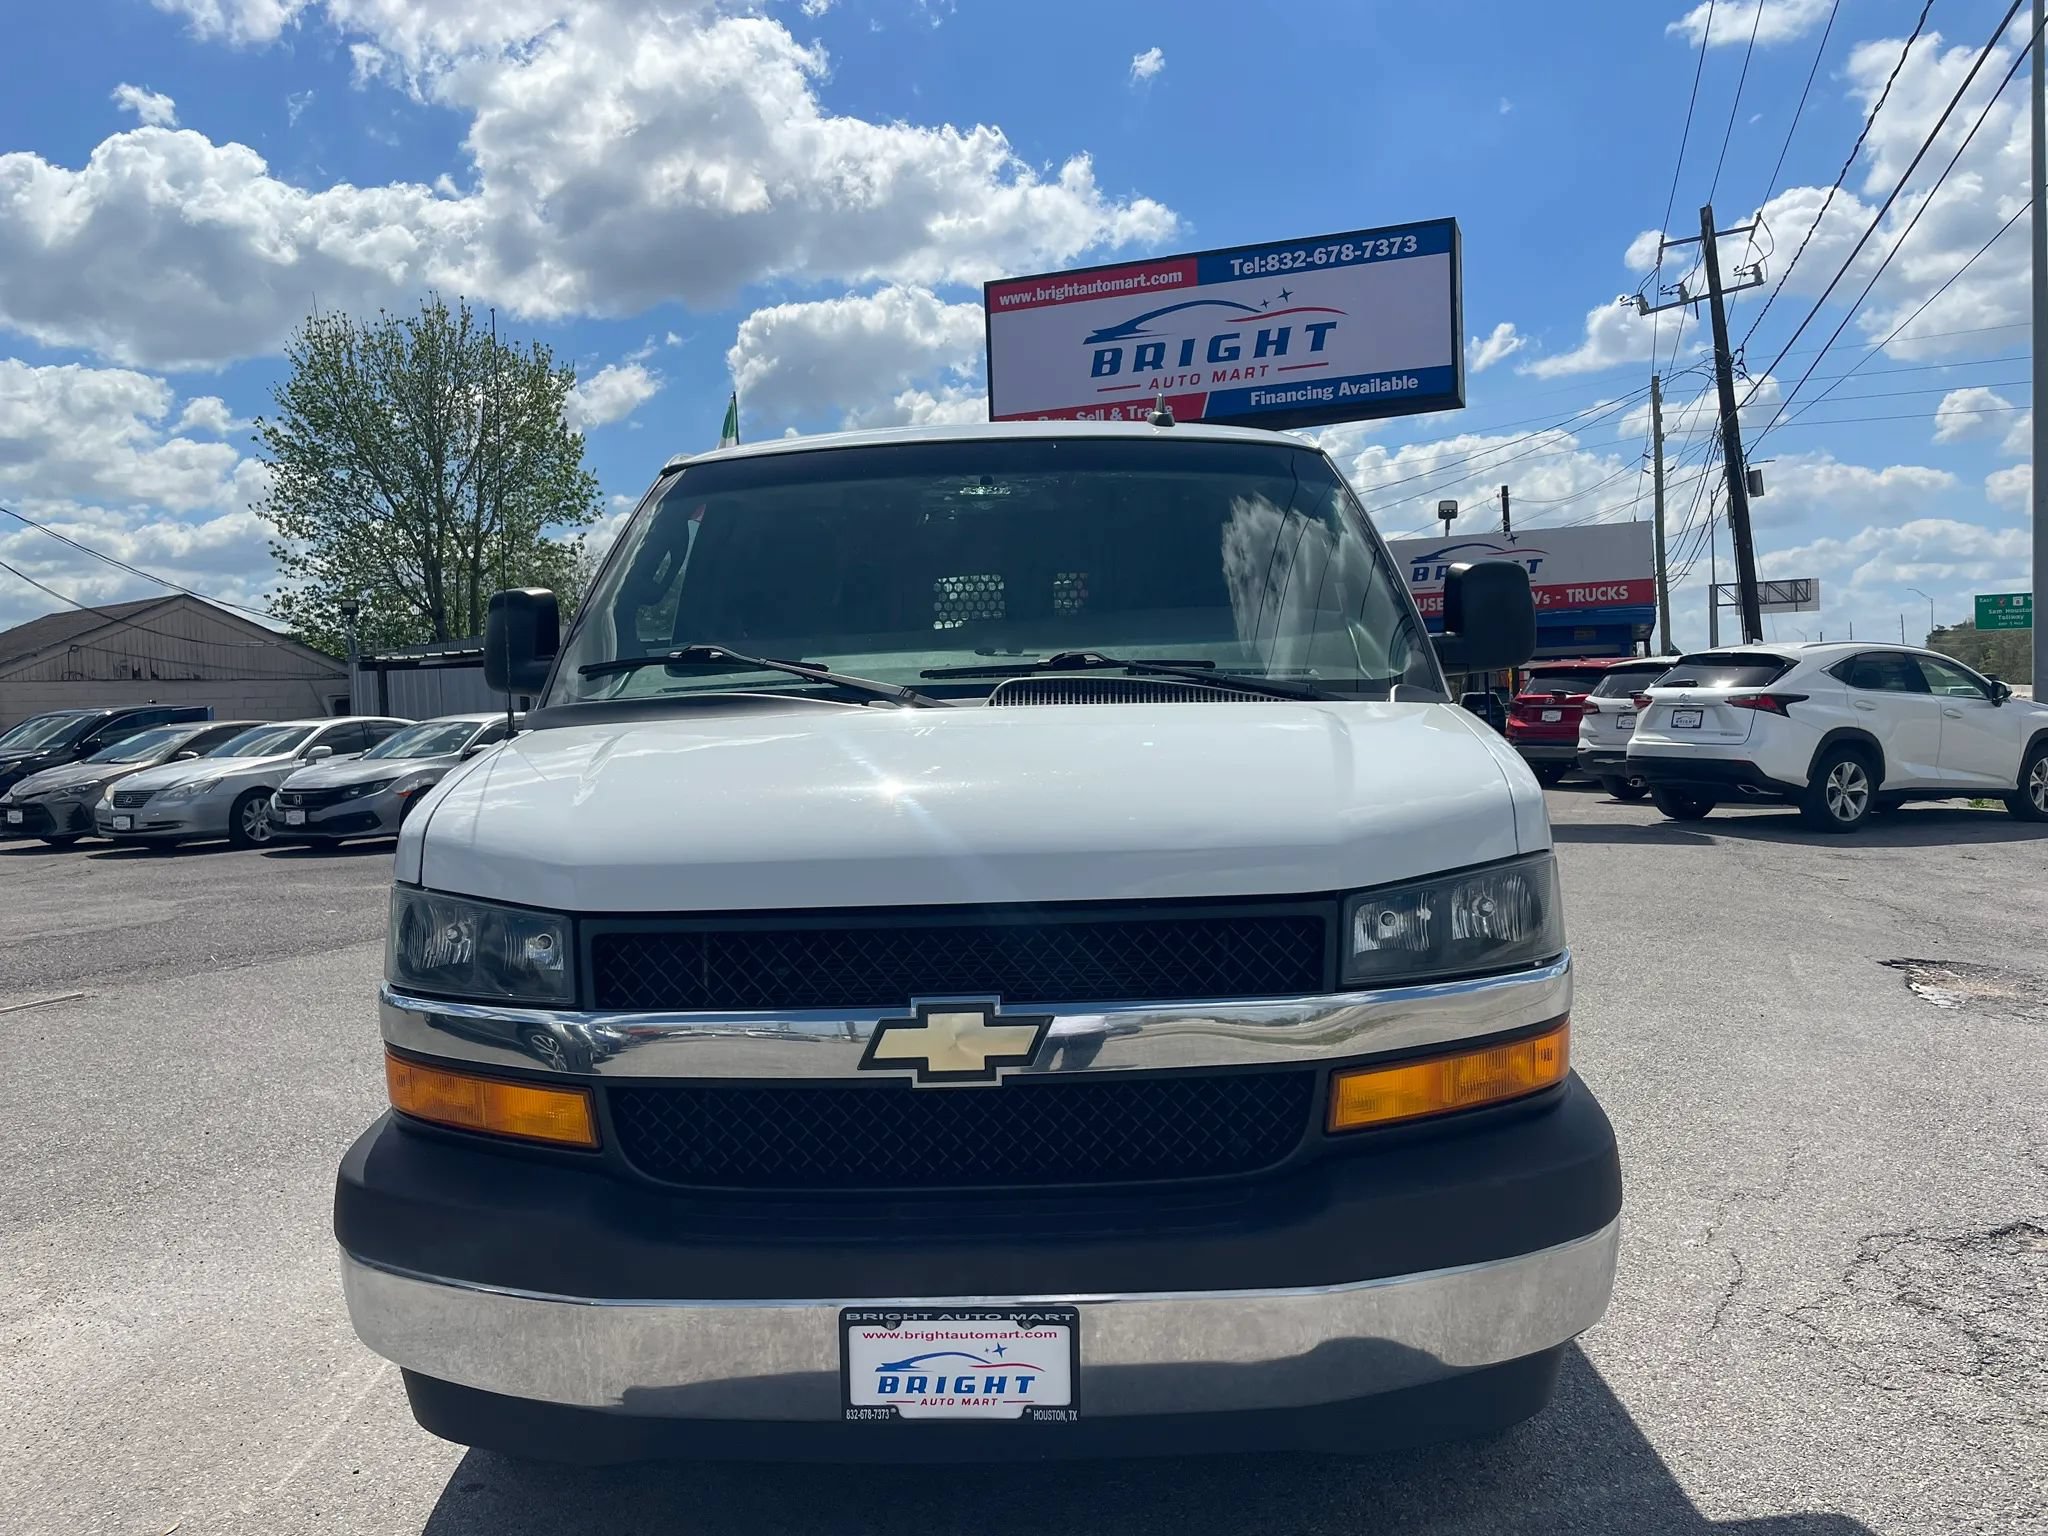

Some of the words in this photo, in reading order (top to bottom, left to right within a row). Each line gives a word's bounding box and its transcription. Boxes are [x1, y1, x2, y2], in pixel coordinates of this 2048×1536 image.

[1230, 235, 1418, 276] Tel:832-678-7373
[999, 269, 1183, 307] www.brightautomart.com
[1090, 321, 1338, 378] BRIGHT
[1148, 373, 1202, 391] AUTO
[1212, 365, 1270, 384] MART
[1250, 385, 1334, 407] Financing
[1338, 376, 1419, 398] Available
[1076, 408, 1105, 421] Sell
[1127, 403, 1174, 420] Trae
[1412, 559, 1543, 582] BRT
[1566, 586, 1629, 602] TRUCKS
[1417, 597, 1444, 611] USE
[862, 1330, 1058, 1342] www.brightautomart.com
[877, 1376, 1036, 1394] BRIGHT
[920, 1398, 955, 1406] AUTO
[961, 1398, 998, 1406] MART
[846, 1409, 890, 1420] 832-678-7373
[1033, 1409, 1068, 1421] HOUSTON,
[1069, 1410, 1078, 1421] TX
